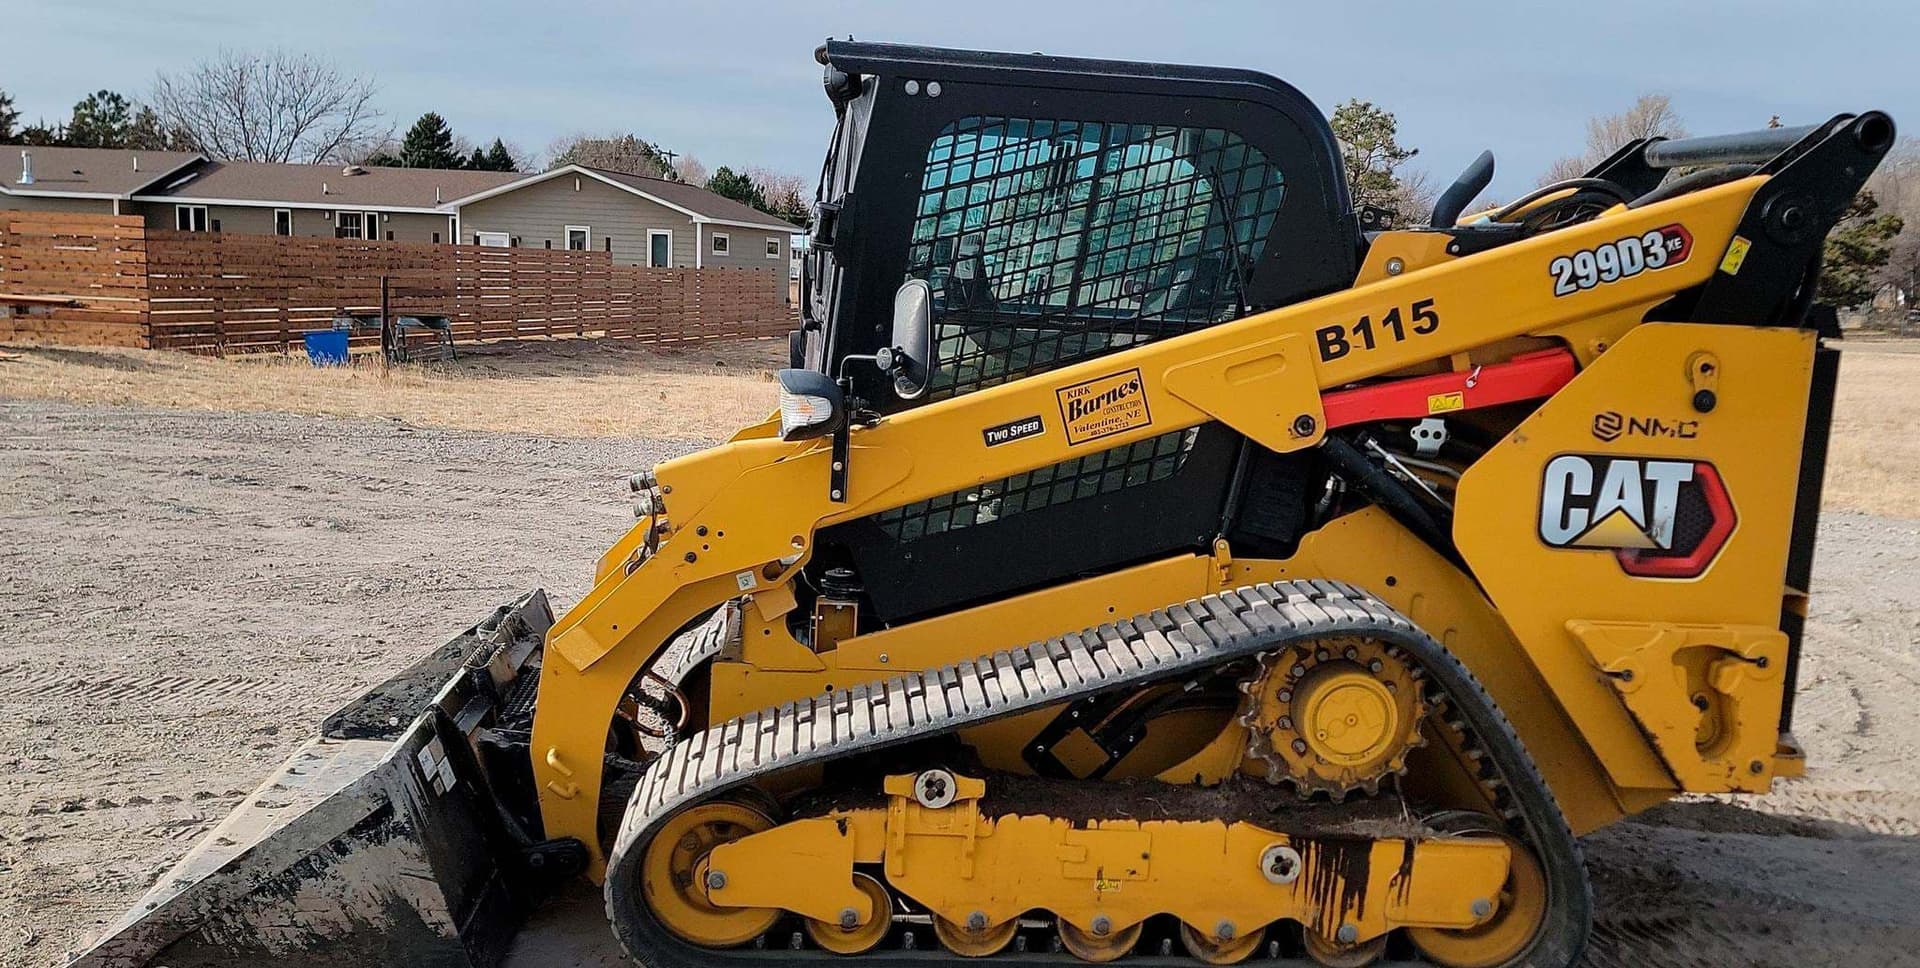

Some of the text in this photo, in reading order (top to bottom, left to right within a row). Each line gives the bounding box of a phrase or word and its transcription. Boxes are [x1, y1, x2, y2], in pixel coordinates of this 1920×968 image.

[1550, 230, 1683, 297] 299D3 XE
[1315, 298, 1439, 362] B115
[1067, 386, 1091, 399] KIRK
[1067, 378, 1139, 424] Barnes
[1074, 409, 1141, 433] Valentine, NE
[1542, 455, 1694, 550] CAT
